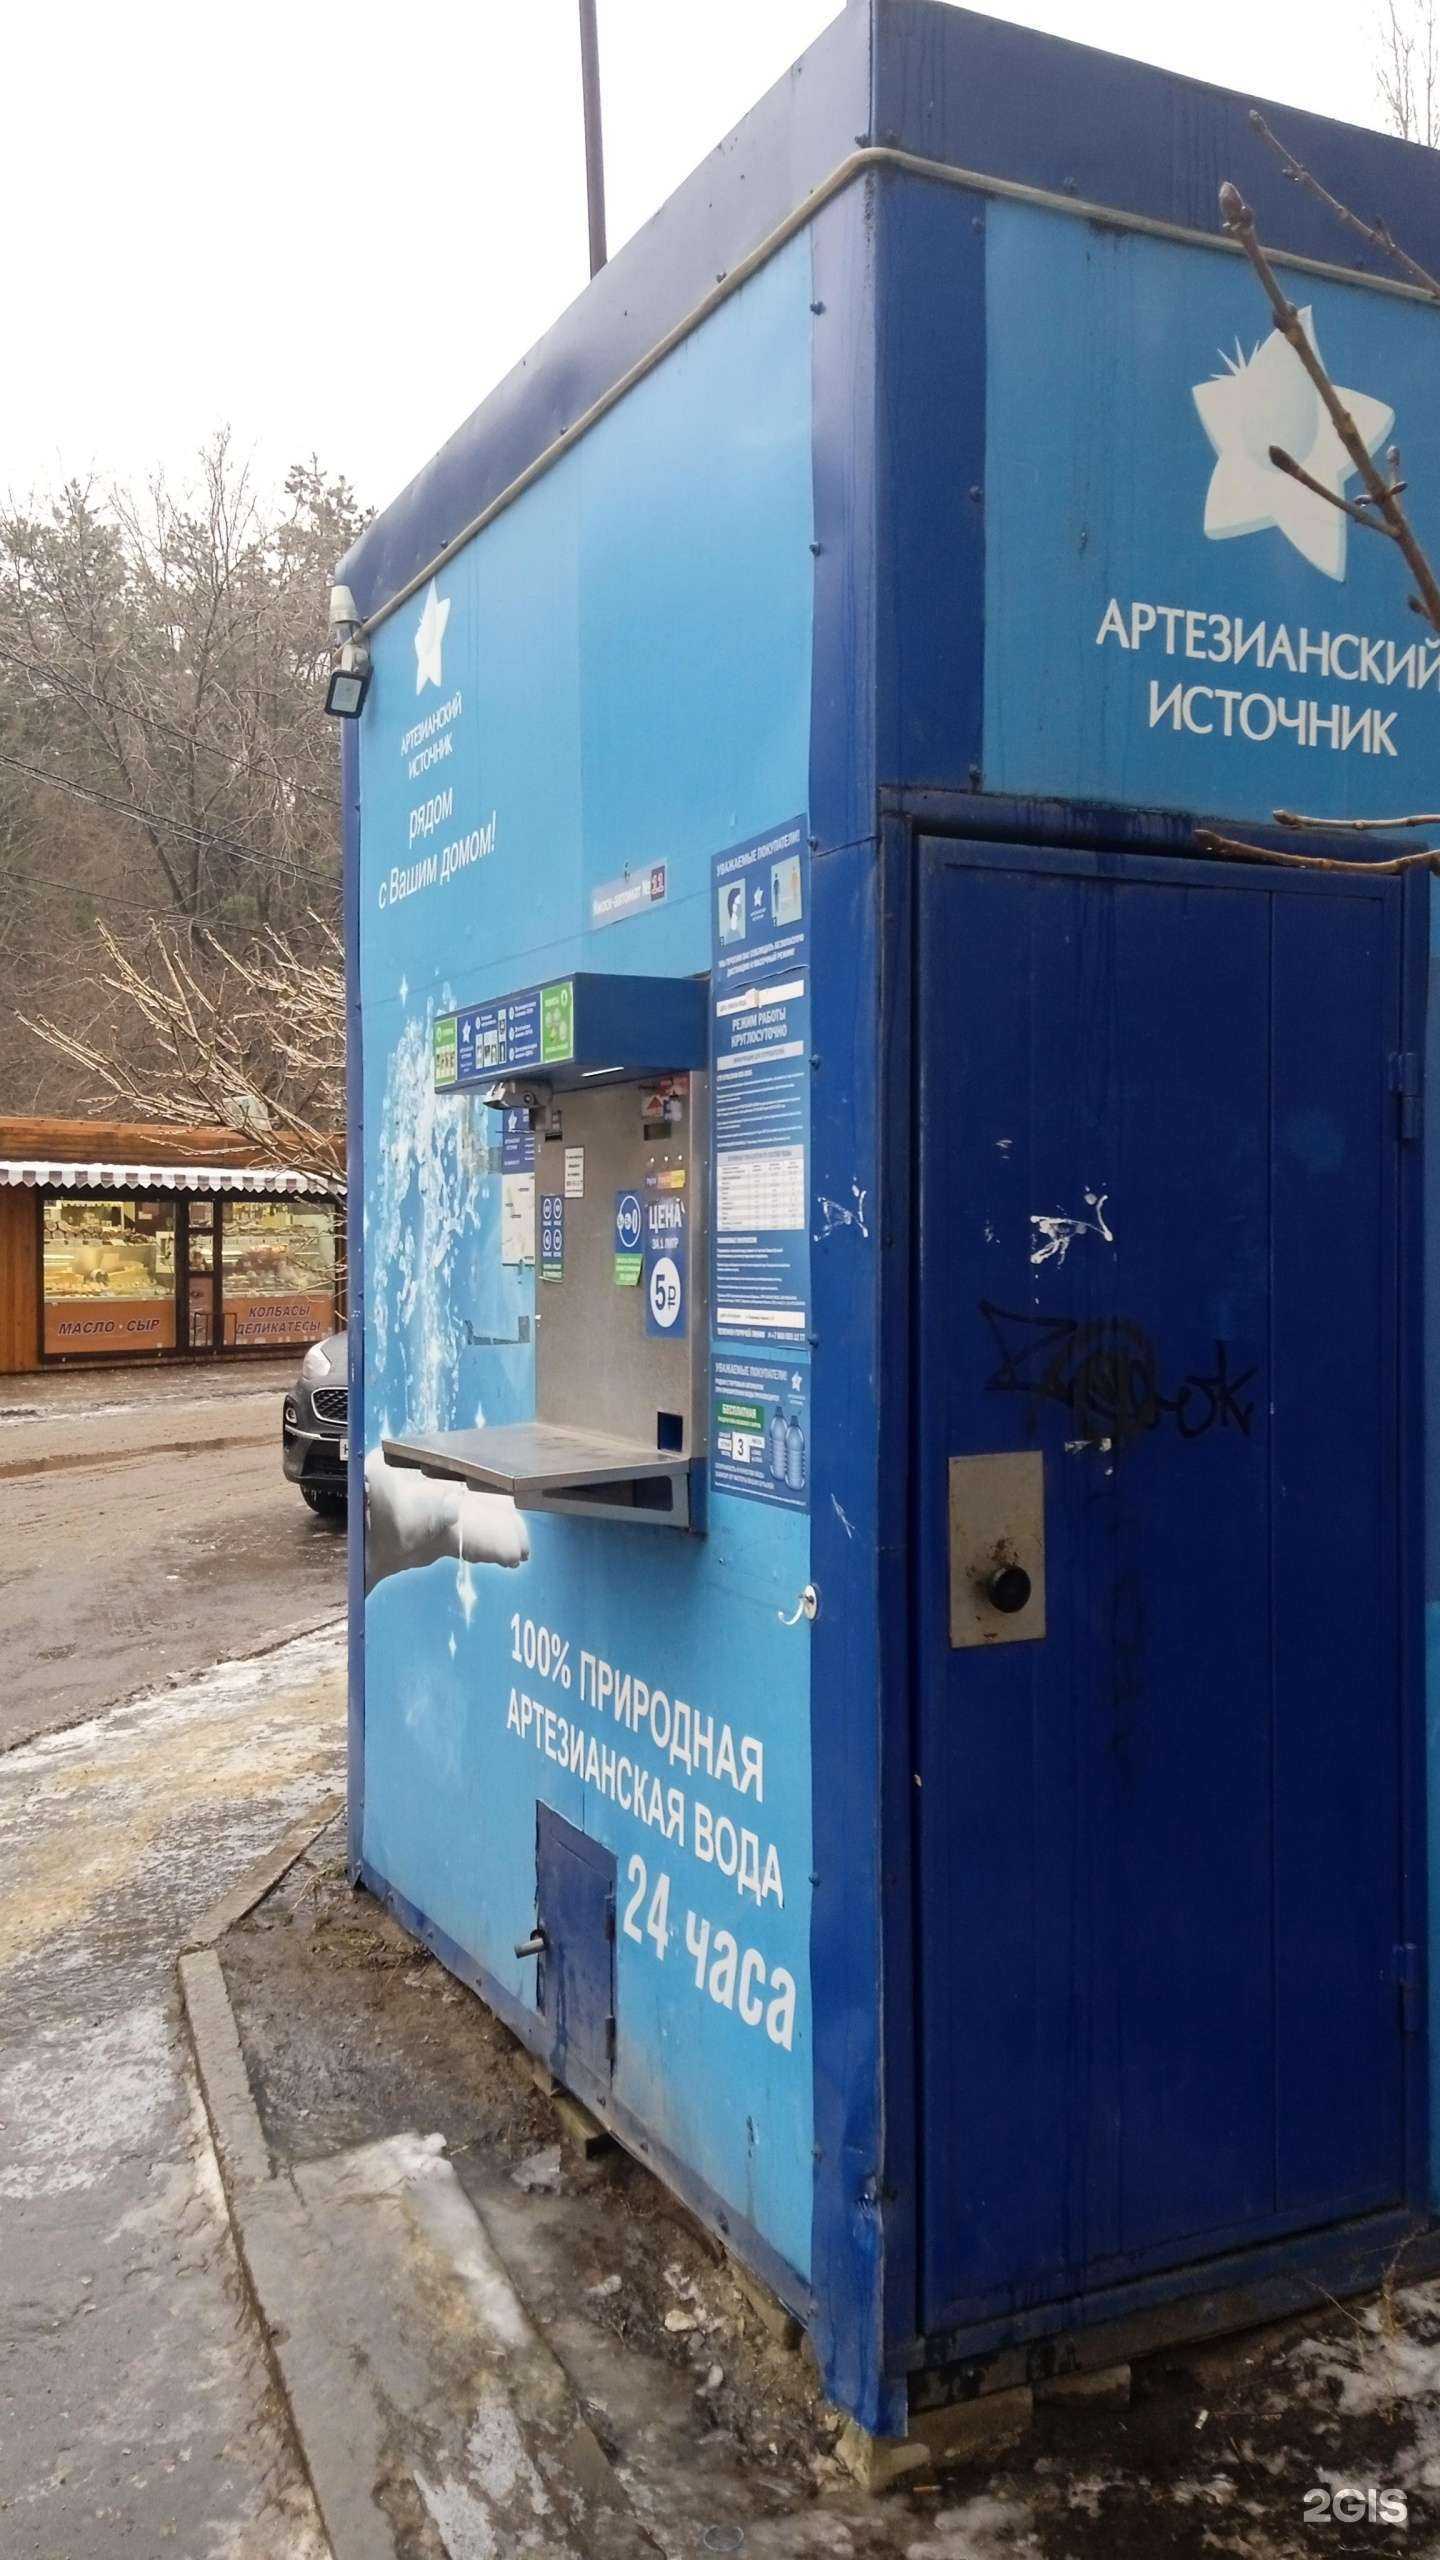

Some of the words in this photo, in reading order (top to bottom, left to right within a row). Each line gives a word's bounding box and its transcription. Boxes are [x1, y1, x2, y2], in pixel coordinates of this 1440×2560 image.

[1095, 597, 1440, 692] АРТЕЗИАНСКИЙ
[401, 690, 462, 757] АРТЕЗИАНСКИЙ
[1147, 680, 1398, 757] ИСТОЧНИК
[408, 731, 453, 779] ИСТОЧНИК
[389, 854, 438, 905] Вашим
[731, 1014, 758, 1032] РЕЖИМ
[758, 1007, 787, 1026] РАБОТЫ
[731, 1024, 788, 1049] КРУГЛОСУТОЧНО
[648, 1202, 683, 1233] ЦЕНА
[58, 1320, 115, 1336] МАСЛО
[126, 1319, 160, 1332] СЫР
[236, 1321, 321, 1336] ДЕЛИКАТЕСЫ
[248, 1305, 311, 1318] КОЛБАСЫ
[509, 1612, 572, 1689] 100%
[579, 1650, 764, 1803] ПРИРОДНАЯ
[506, 1687, 685, 1848] АРТЕЗИАНСКАЯ
[694, 1801, 785, 1910] ВОДА
[622, 1853, 672, 1961] 24
[685, 1909, 798, 2053] часа
